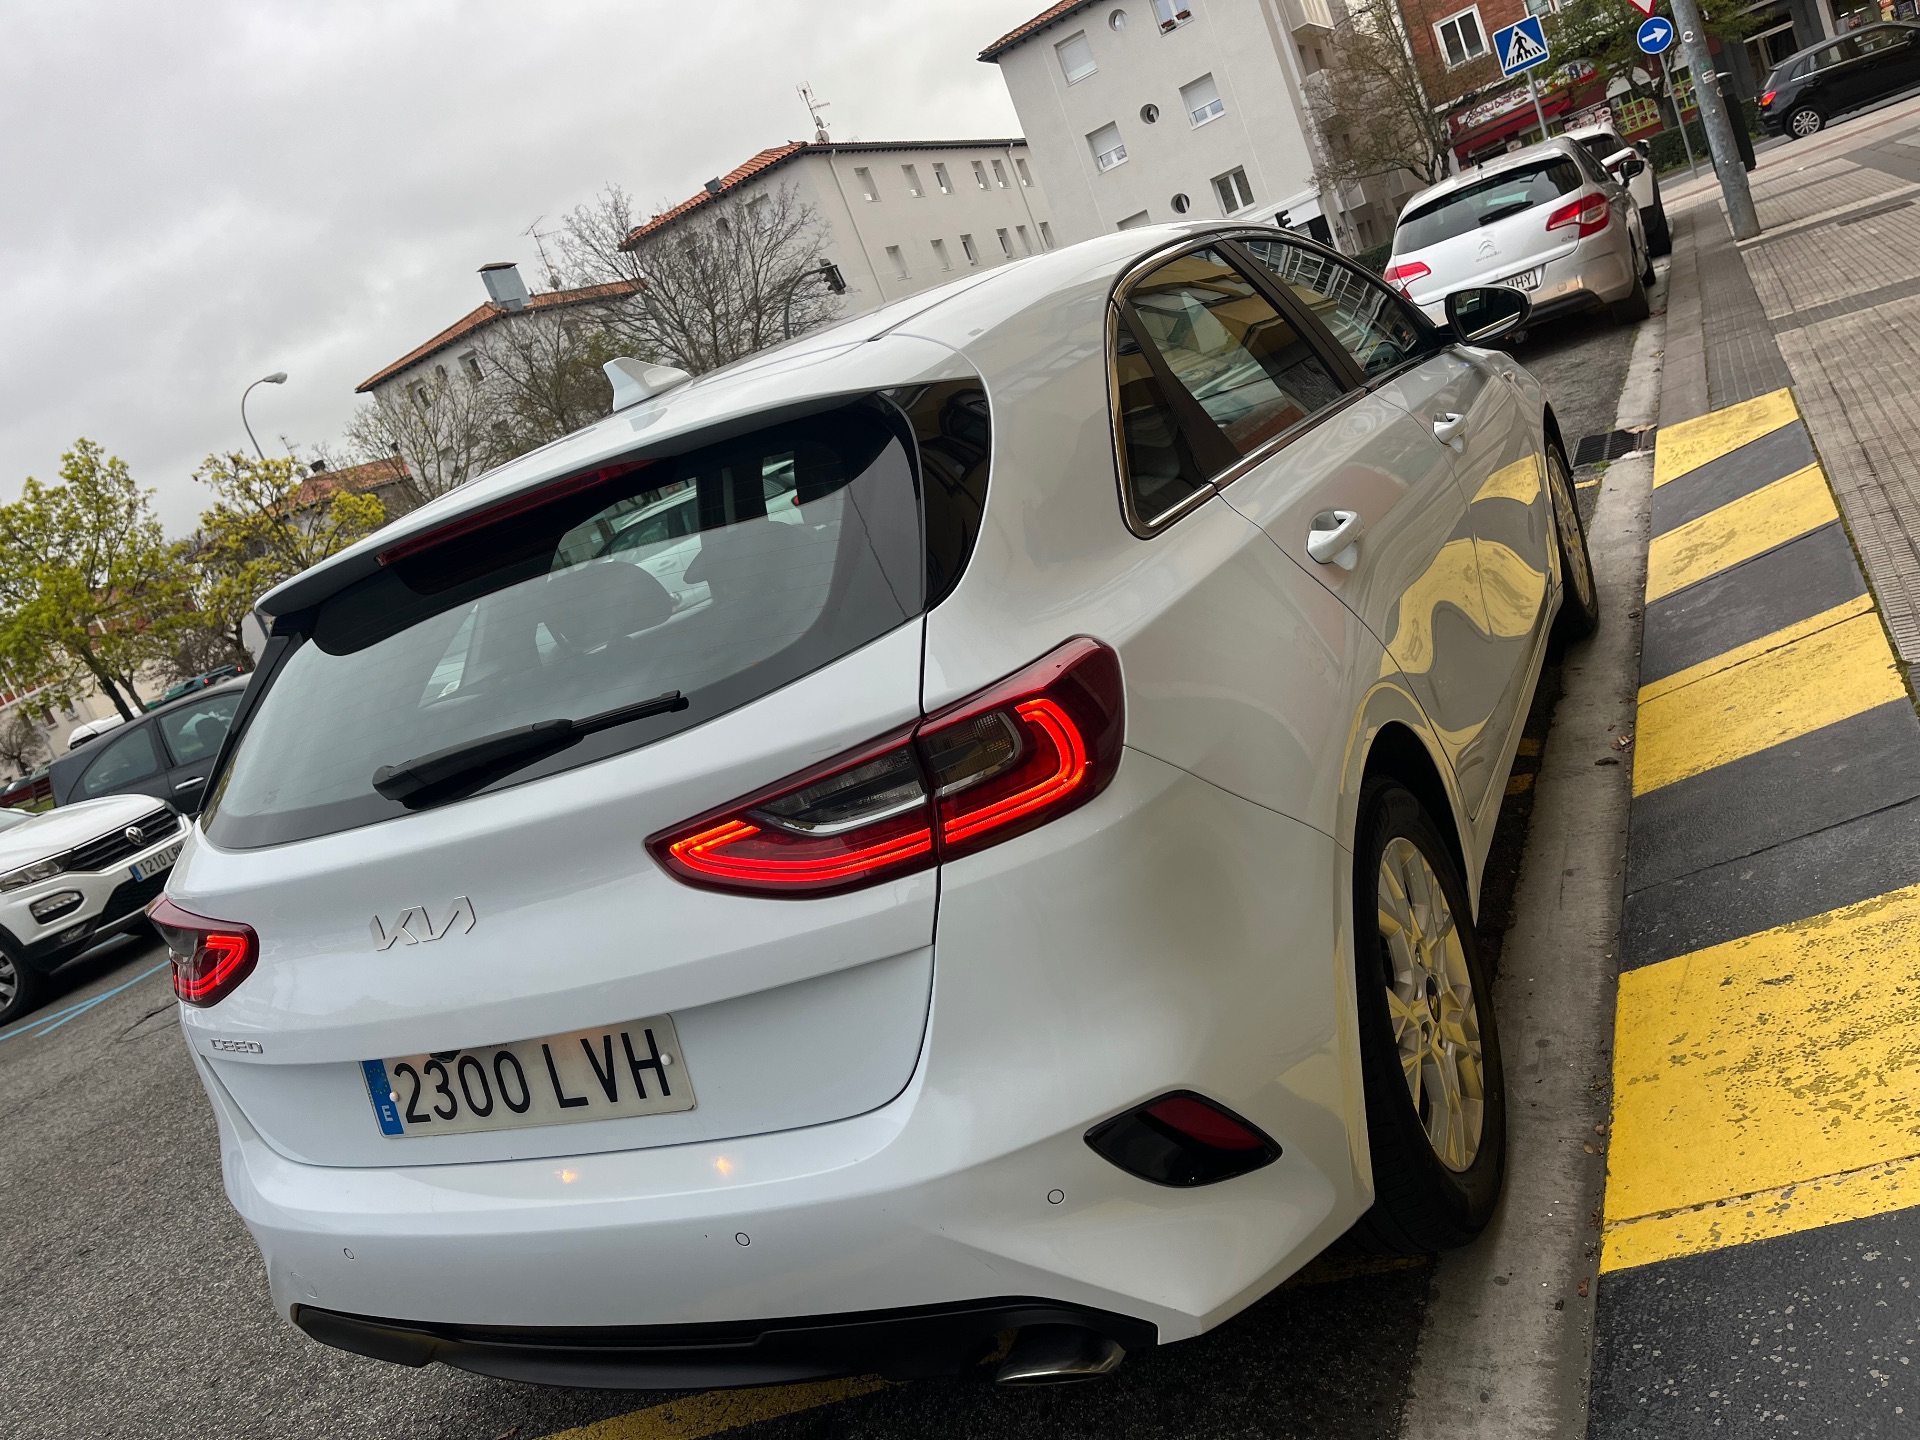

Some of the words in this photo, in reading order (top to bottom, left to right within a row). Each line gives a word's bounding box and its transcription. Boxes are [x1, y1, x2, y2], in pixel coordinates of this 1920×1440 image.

[140, 854, 167, 875] 1210
[369, 895, 476, 952] KIA
[210, 1038, 263, 1054] CEED
[394, 1050, 530, 1124] 2300
[541, 1028, 671, 1109] LVH
[381, 1104, 393, 1122] E
